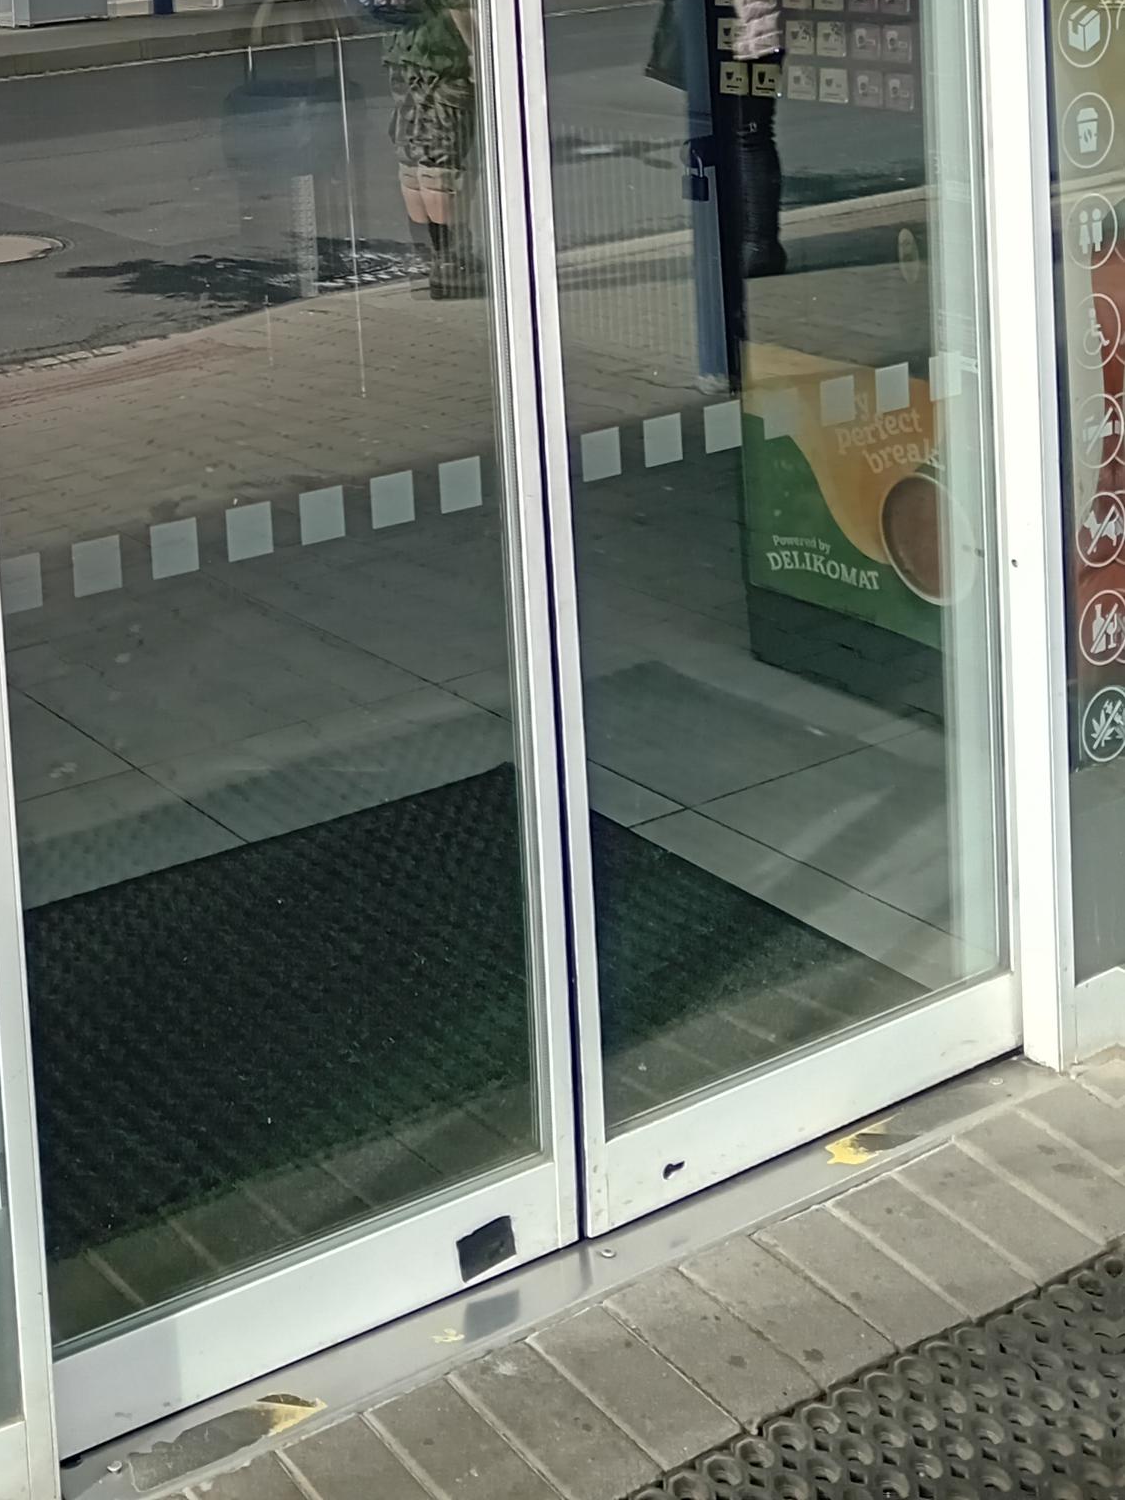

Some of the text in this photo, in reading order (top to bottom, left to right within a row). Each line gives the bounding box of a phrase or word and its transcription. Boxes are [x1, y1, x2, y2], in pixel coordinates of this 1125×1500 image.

[772, 534, 831, 554] Powered by
[765, 549, 880, 590] DELIKOMAT
